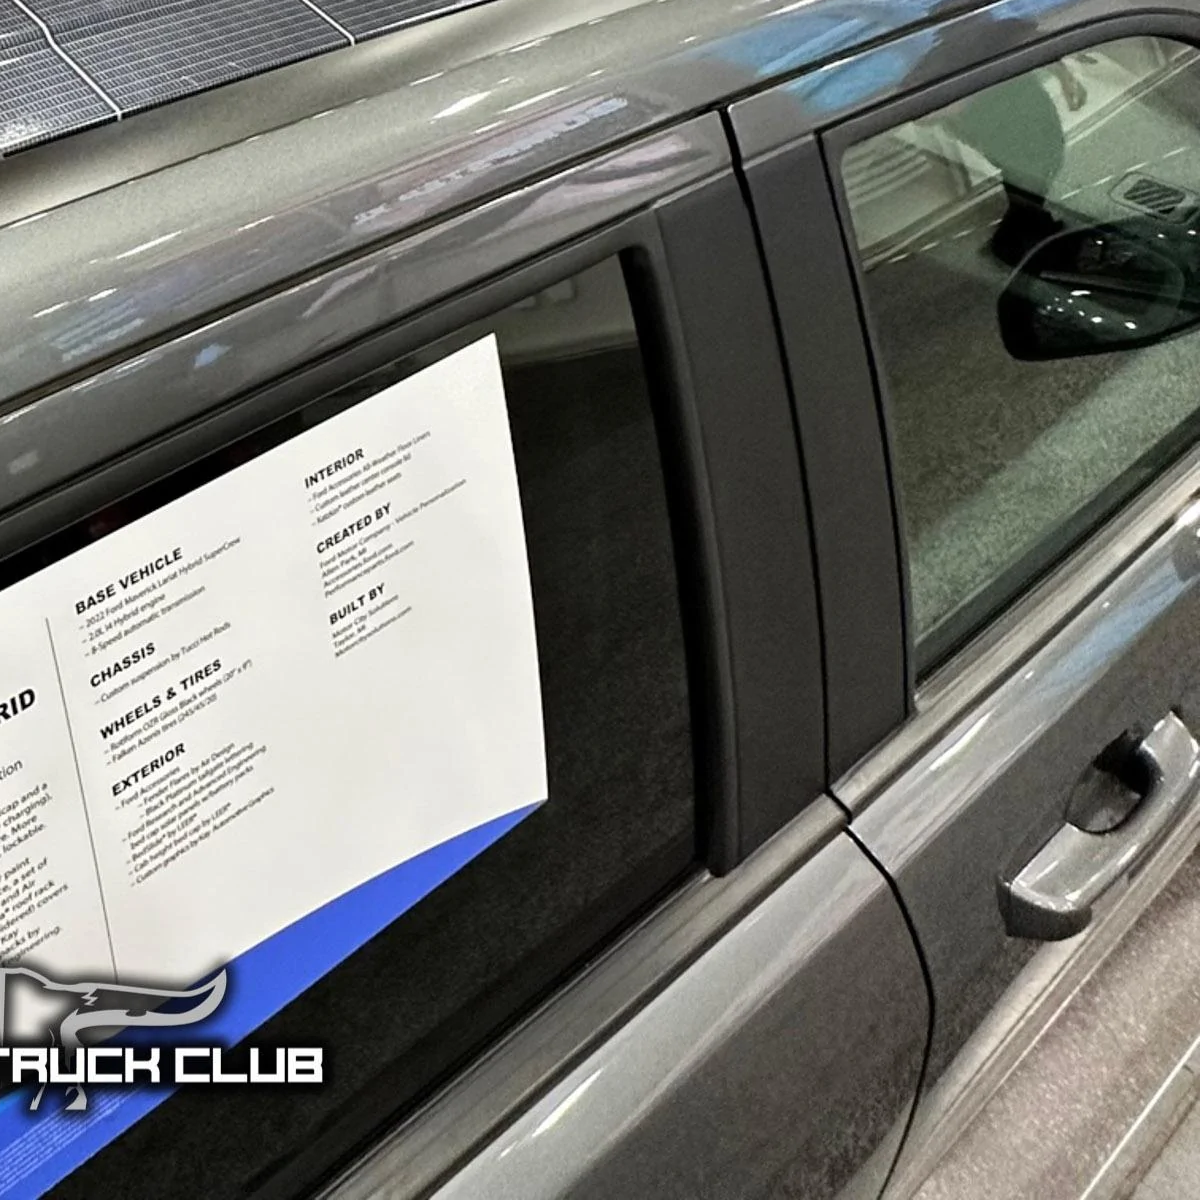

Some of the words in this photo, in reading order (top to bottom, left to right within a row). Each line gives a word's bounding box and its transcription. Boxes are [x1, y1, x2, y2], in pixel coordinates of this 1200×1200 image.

[305, 449, 364, 488] INTERIOR
[317, 515, 372, 553] CREATED
[375, 503, 390, 520] BY
[76, 584, 116, 615] BASE
[119, 548, 182, 589] VEHICLE
[330, 595, 365, 625] BUILT
[369, 583, 384, 600] BY
[90, 643, 155, 687] CHASSIS
[100, 696, 161, 739] WHEELS
[167, 687, 176, 700] &
[180, 660, 221, 690] TIRES
[112, 743, 185, 796] EXTERIOR
